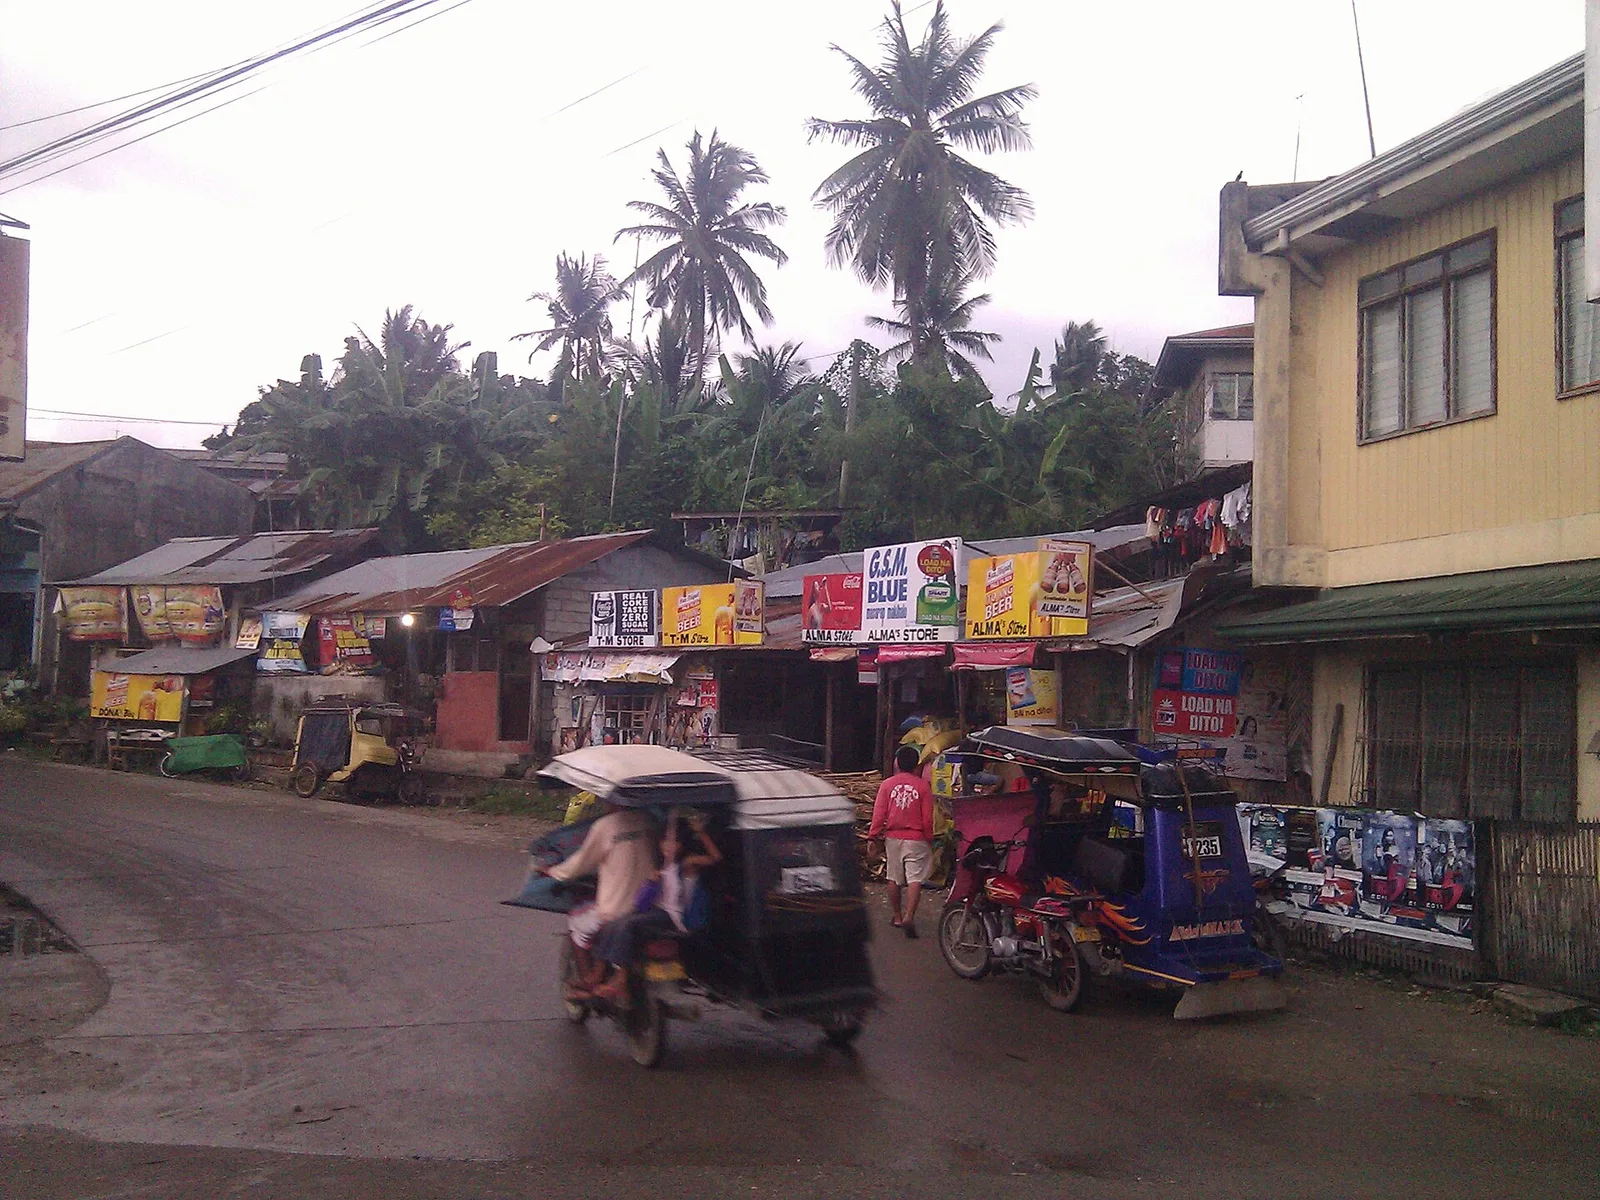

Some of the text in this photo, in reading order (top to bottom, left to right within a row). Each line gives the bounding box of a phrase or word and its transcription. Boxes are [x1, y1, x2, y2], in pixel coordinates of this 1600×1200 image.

[869, 547, 908, 579] G.S.M.
[622, 592, 648, 600] REAL
[868, 579, 908, 603] BLUE
[622, 613, 648, 621] ZERO
[985, 596, 1013, 621] BEER
[677, 616, 701, 633] BEER
[1007, 621, 1027, 636] Store
[617, 636, 644, 645] STORE
[805, 630, 832, 641] ALMA
[903, 628, 939, 641] STORE
[1187, 652, 1218, 670] LOAD
[1193, 671, 1230, 690] DITO!
[1181, 695, 1232, 715] LOAD NA
[1189, 715, 1224, 732] DITO!
